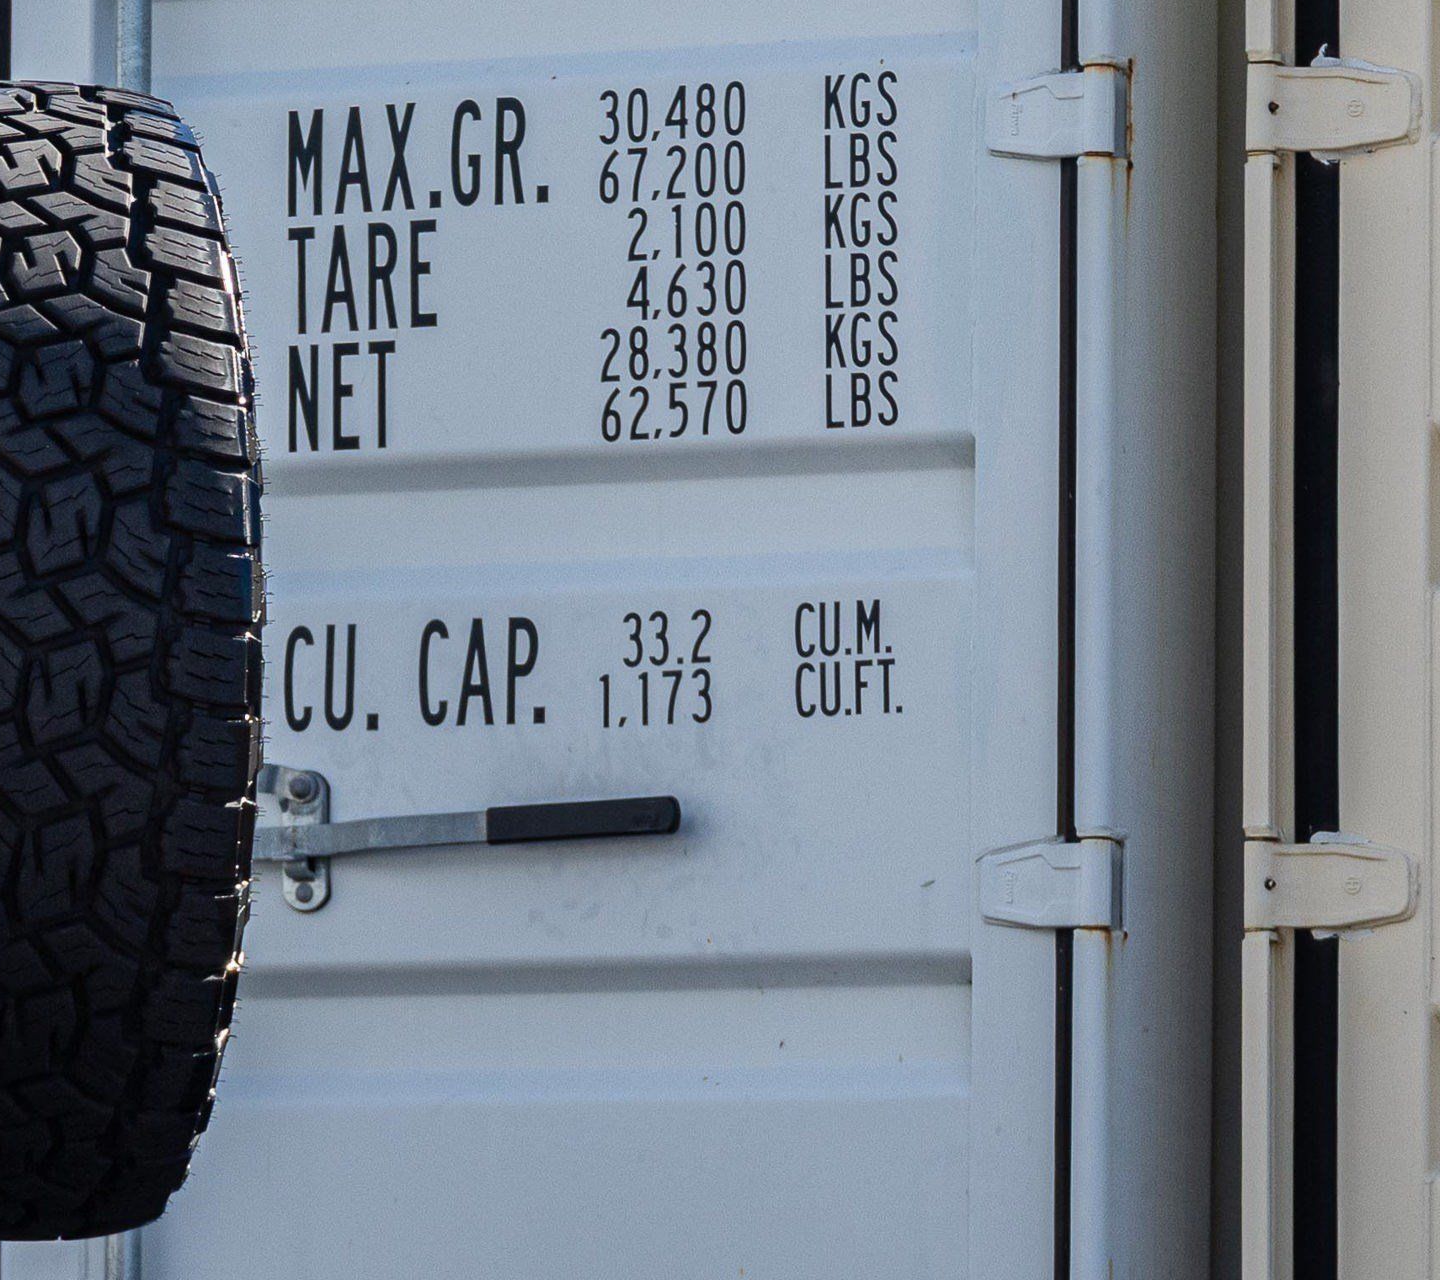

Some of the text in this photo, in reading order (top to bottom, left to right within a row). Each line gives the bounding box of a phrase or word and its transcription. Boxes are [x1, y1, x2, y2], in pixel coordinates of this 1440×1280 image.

[599, 71, 898, 145] 30,480 KGS
[288, 97, 550, 217] MAX.GR.
[599, 131, 898, 204] 67,200 LBS
[627, 191, 898, 261] 2,100 KGS
[288, 219, 438, 335] TARE
[626, 250, 899, 320] 4,630 LBS
[600, 311, 899, 383] 28,380 KGS
[288, 340, 396, 453] NET
[601, 370, 899, 443] 62,570 LBS
[623, 599, 893, 668] 33.2 CU.M.
[284, 617, 547, 733] CU. CAP.
[599, 658, 904, 728] 1,173 CU.FT.
